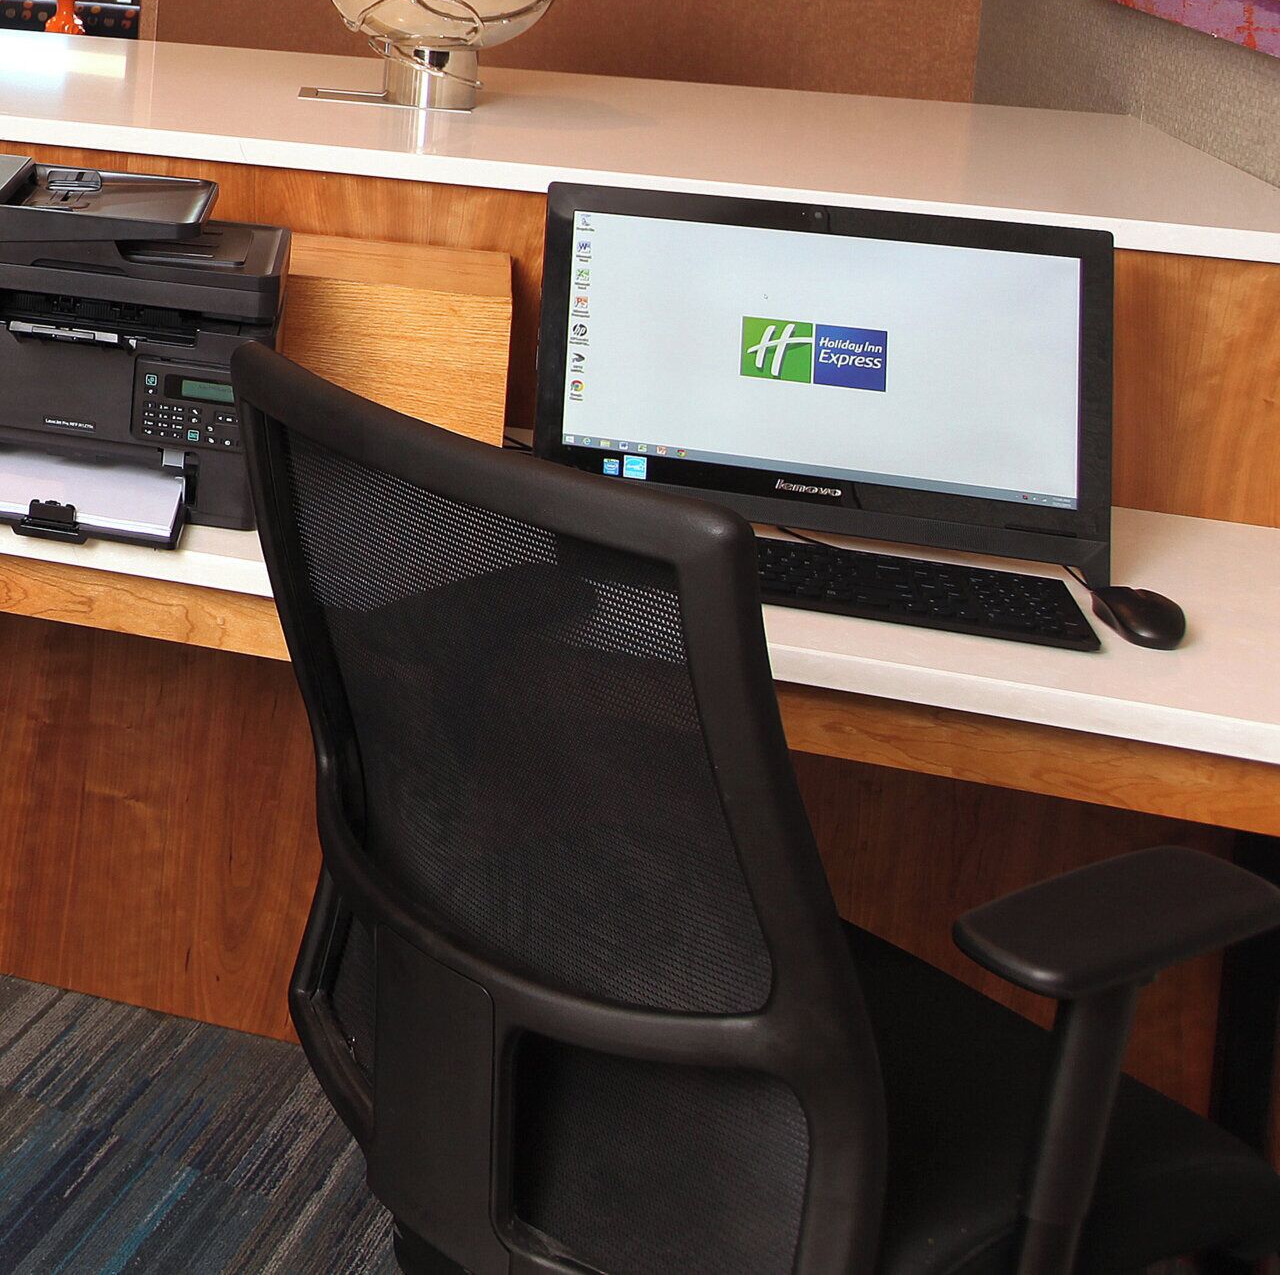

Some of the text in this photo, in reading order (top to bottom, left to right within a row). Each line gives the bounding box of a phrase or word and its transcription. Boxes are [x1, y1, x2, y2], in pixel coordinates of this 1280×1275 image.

[819, 337, 882, 353] Holiday Inn
[818, 349, 882, 369] Express
[775, 478, 842, 497] lenovo
